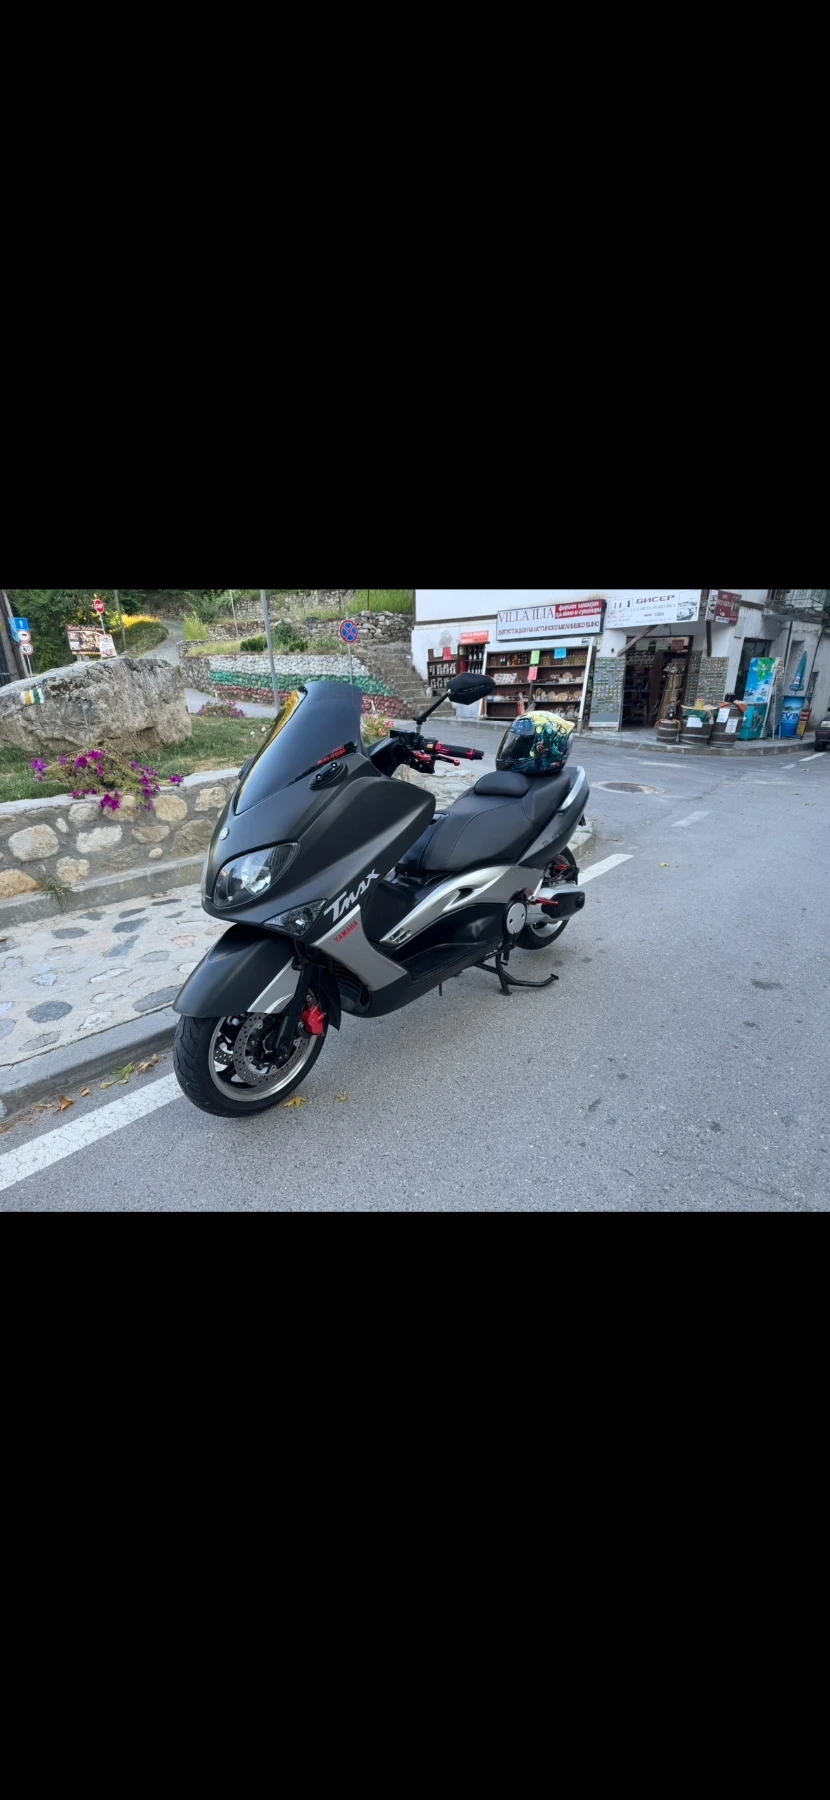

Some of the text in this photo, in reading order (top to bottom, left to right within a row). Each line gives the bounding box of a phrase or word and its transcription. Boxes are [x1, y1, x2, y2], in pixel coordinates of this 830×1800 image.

[636, 595, 675, 604] БИСЕР
[498, 607, 555, 623] VILLA ILIA
[334, 920, 359, 942] YAMAHA
